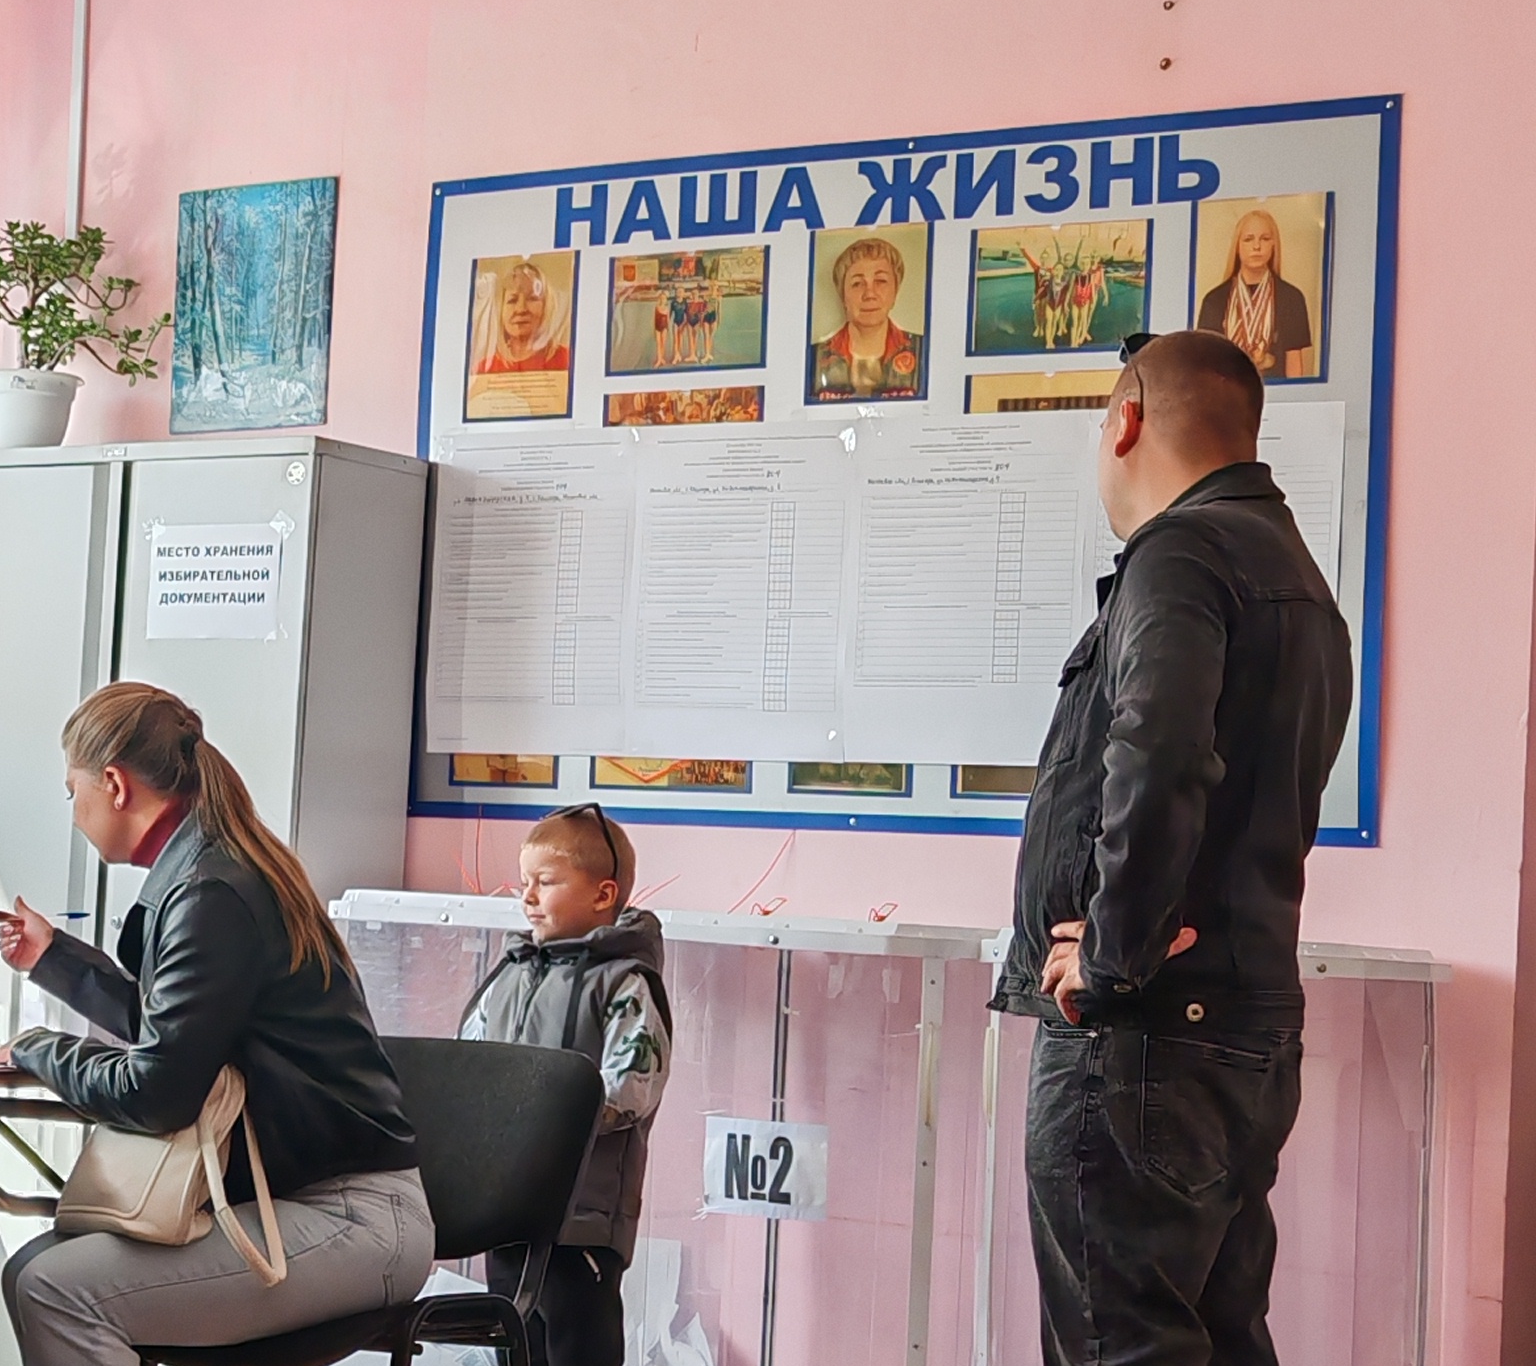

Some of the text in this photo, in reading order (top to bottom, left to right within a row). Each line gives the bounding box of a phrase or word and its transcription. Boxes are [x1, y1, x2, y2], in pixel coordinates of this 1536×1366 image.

[553, 134, 1222, 249] НАША ЖИЗНЬ
[156, 544, 274, 558] МЕСТО ХРАНЕНИЯ
[158, 567, 270, 582] ИЗБИРАТЕЛЬНОЙ
[159, 591, 266, 606] ДОКУМЕНТАЦИИ
